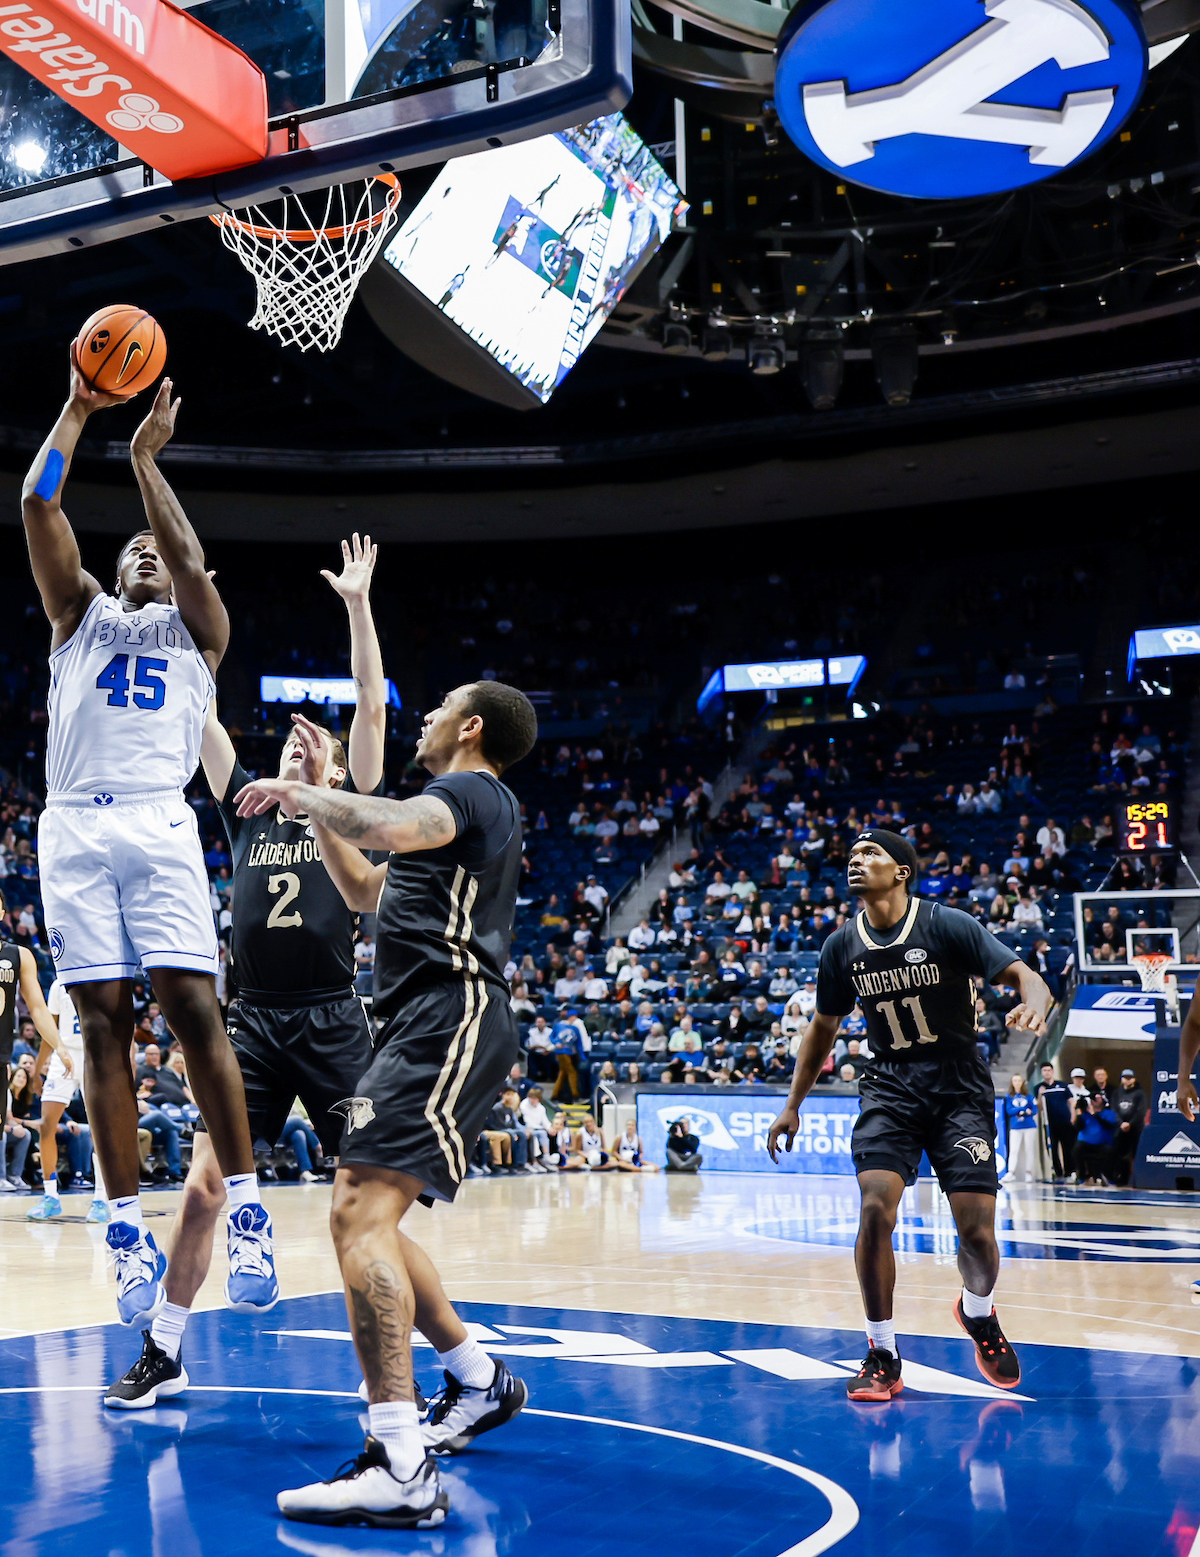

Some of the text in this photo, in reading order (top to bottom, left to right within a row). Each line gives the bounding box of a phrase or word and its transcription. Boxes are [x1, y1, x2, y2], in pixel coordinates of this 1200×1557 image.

[89, 615, 183, 658] BYU
[96, 653, 168, 711] 45
[1127, 802, 1168, 821] 15:29
[248, 840, 323, 867] LINDENWOO
[1128, 821, 1168, 850] 21
[266, 872, 303, 929] 2
[852, 963, 940, 997] LINDENWOOD
[875, 995, 938, 1050] 11
